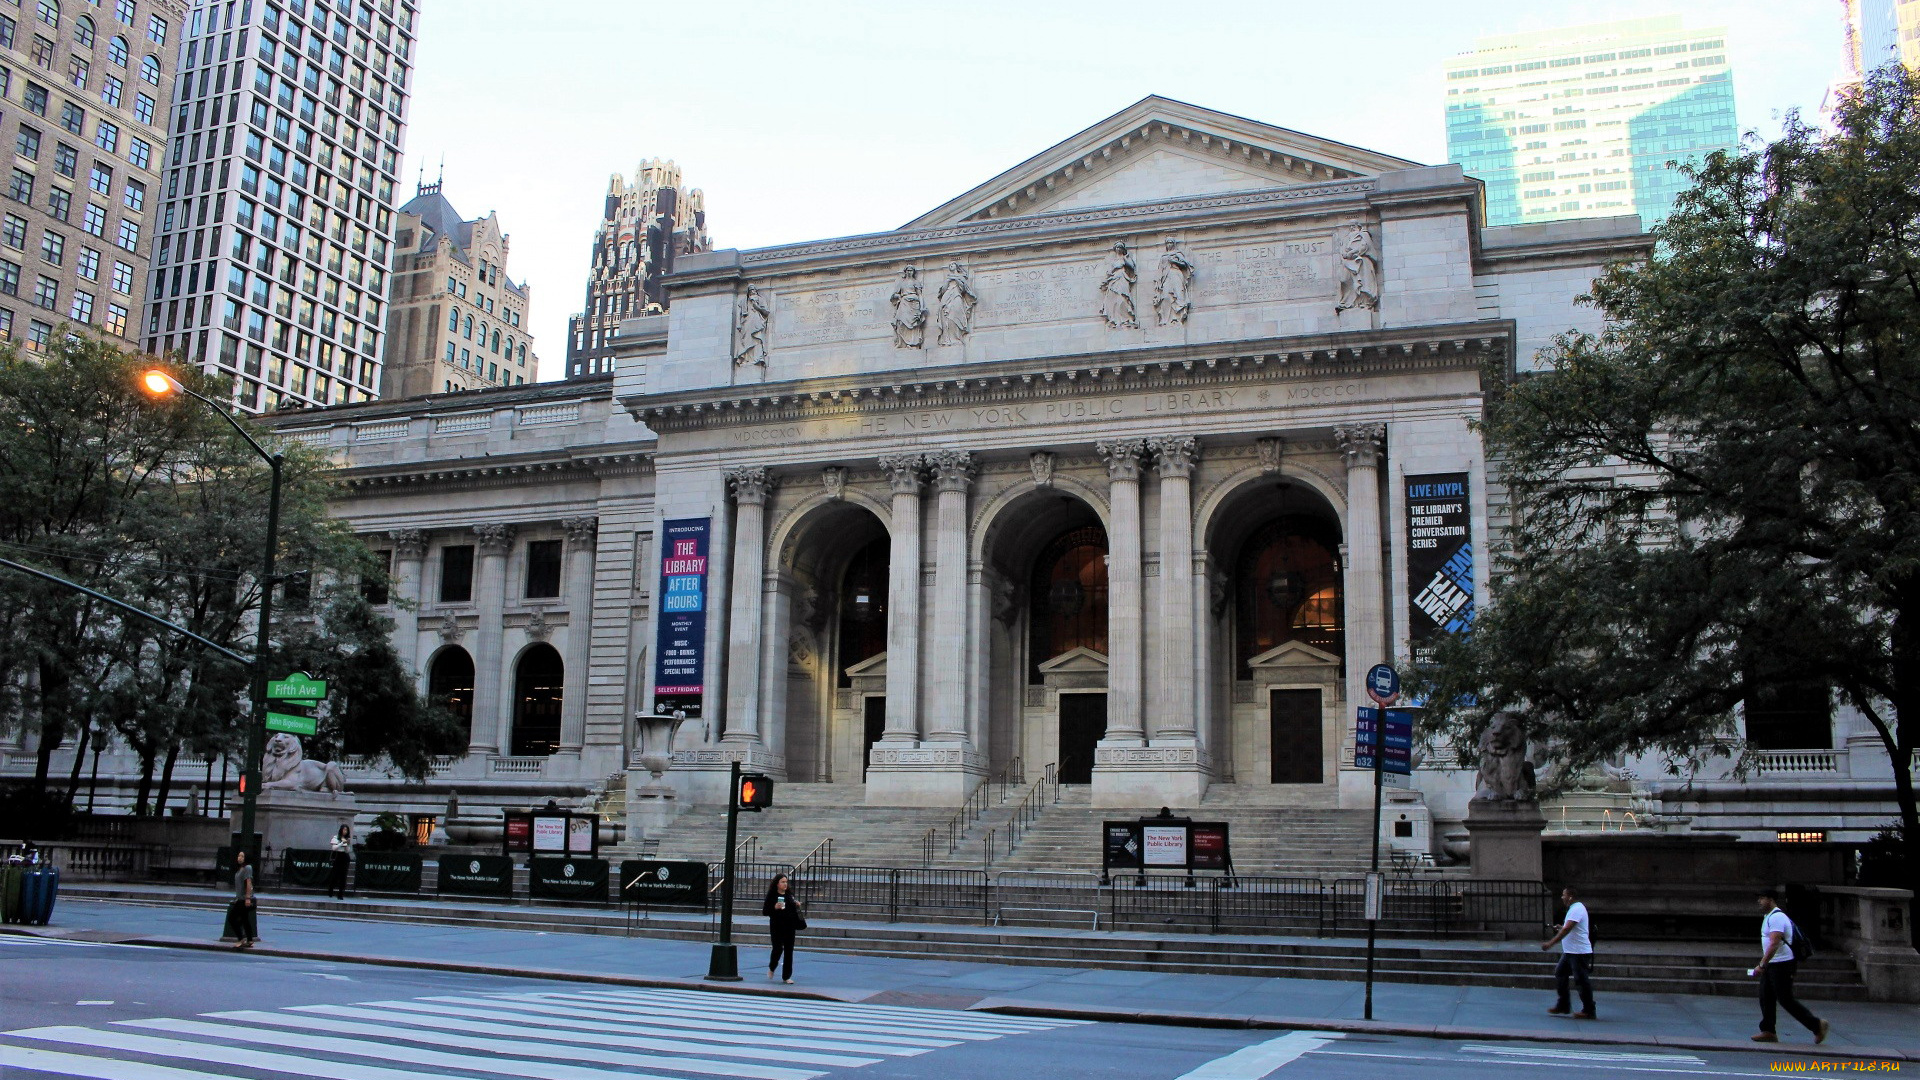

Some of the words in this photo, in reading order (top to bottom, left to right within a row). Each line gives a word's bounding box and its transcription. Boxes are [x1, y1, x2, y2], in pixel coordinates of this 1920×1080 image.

[1199, 252, 1222, 264] THE
[1232, 246, 1276, 260] TILDEN
[1285, 242, 1324, 255] TRUST
[981, 274, 1003, 285] THE
[1008, 270, 1045, 283] LENOX
[1051, 264, 1099, 279] LIBRARY
[1250, 268, 1278, 277] JONES
[1282, 266, 1313, 274] TILDEN
[783, 296, 801, 307] THE
[808, 292, 840, 305] ASTOR
[846, 286, 889, 300] LIBRARY
[1007, 292, 1035, 301] JAMES
[1042, 287, 1072, 297] LENOX
[850, 308, 874, 318] ASTOR
[734, 427, 804, 442] MDCCCXCV
[847, 416, 888, 436] THE
[904, 412, 954, 430] NEW
[973, 406, 1028, 426] YORK
[1045, 400, 1123, 419] PUBLIC
[1144, 390, 1239, 412] LIBRARY
[1410, 484, 1431, 498] LIVE
[1437, 483, 1464, 496] NYPL
[1411, 506, 1424, 515] THE
[1426, 504, 1462, 514] LIBRARY'S
[1412, 516, 1442, 526] PREMIER
[1412, 526, 1464, 537] CONVERSATION
[677, 542, 694, 555] THE
[1412, 539, 1437, 548] SERIES
[666, 558, 704, 574] LIBRARY
[670, 578, 698, 591] AFTER
[1427, 570, 1468, 612] NYPL
[668, 595, 698, 609] HOURS
[1413, 587, 1450, 622] LIVE
[275, 684, 296, 695] Fifth
[299, 684, 317, 695] Ave
[1359, 710, 1368, 718] M1
[269, 716, 282, 725] John
[283, 718, 304, 729] Bigelow
[1358, 721, 1368, 730] M1
[1358, 733, 1369, 742] M4
[1357, 745, 1368, 754] M4
[1356, 757, 1372, 766] Q32
